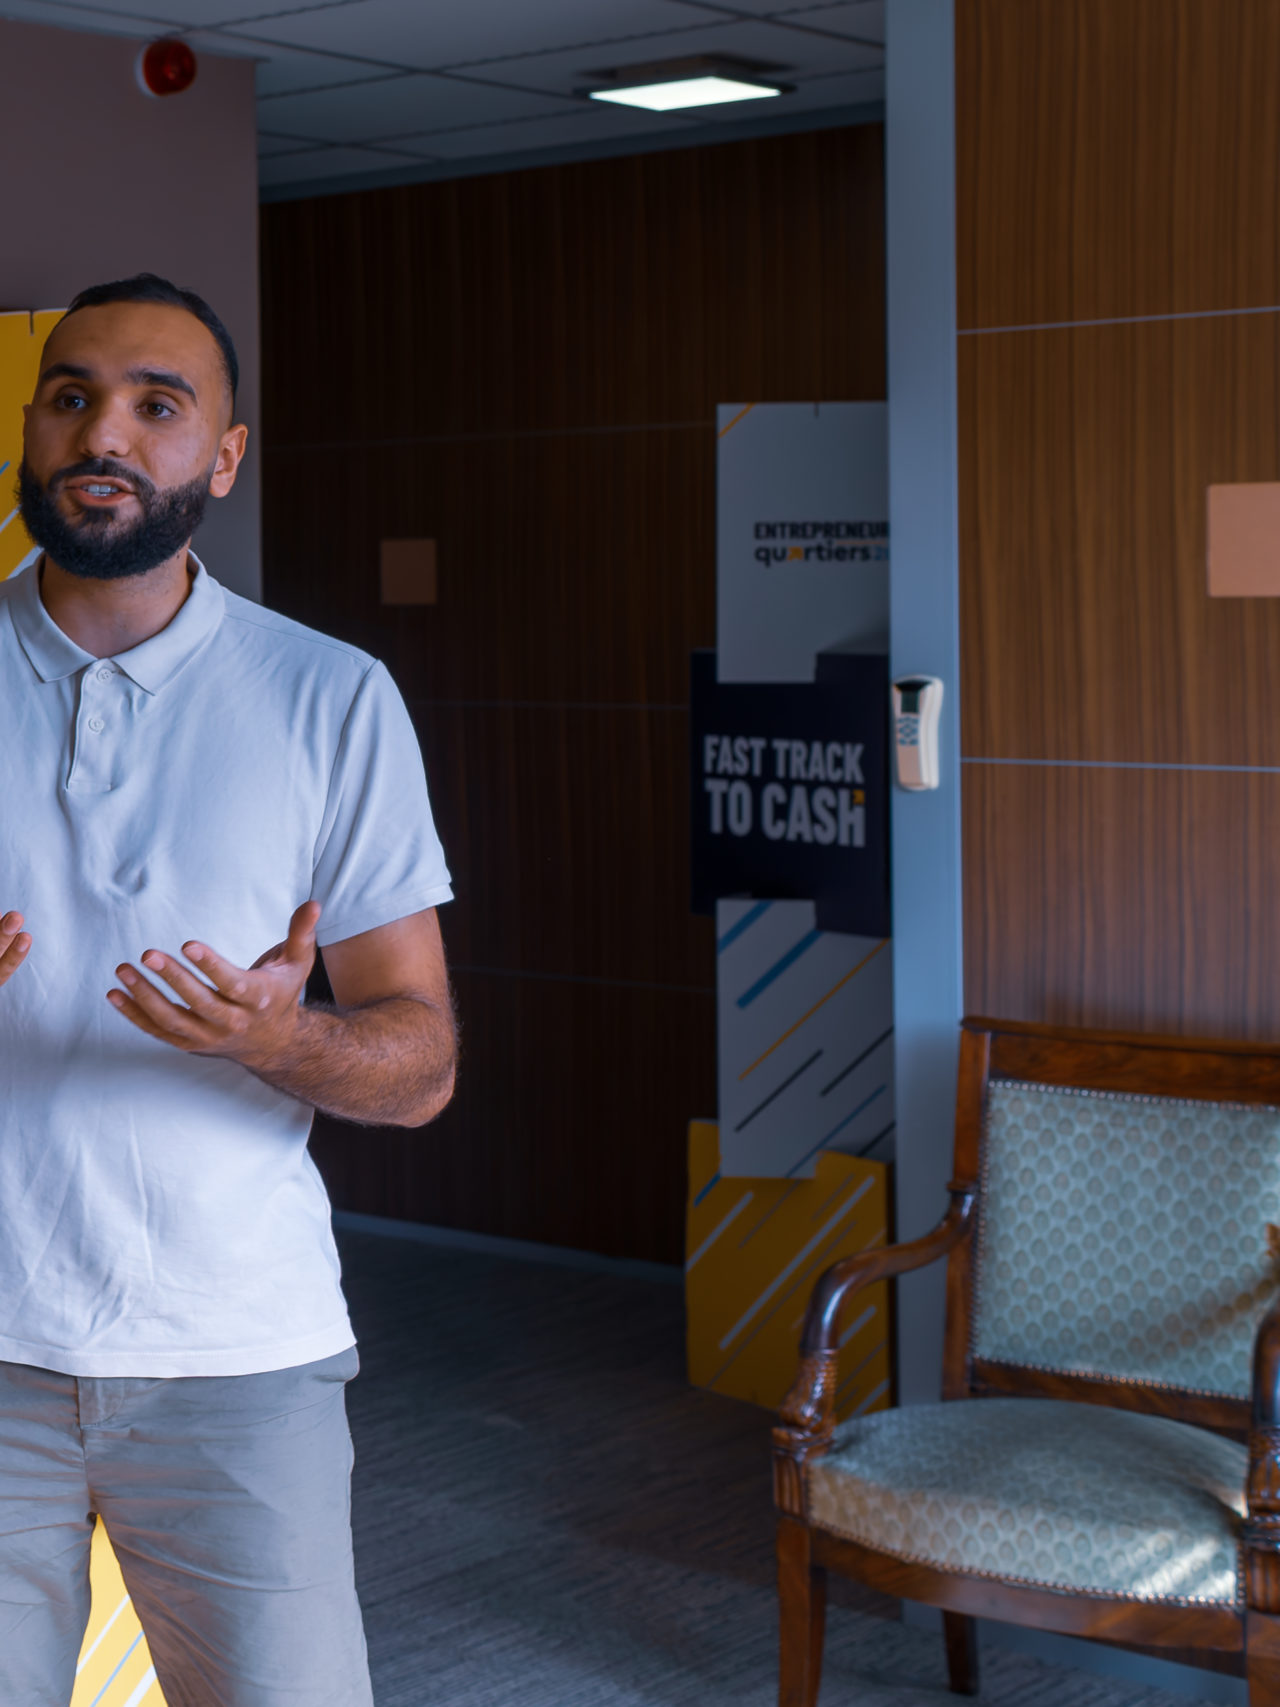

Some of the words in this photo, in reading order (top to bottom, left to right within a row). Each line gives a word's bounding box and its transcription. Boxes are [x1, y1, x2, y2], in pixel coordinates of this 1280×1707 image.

[704, 735, 766, 776] FAST
[772, 738, 864, 784] TRACK
[704, 778, 752, 836] TO
[762, 783, 866, 848] CASH
